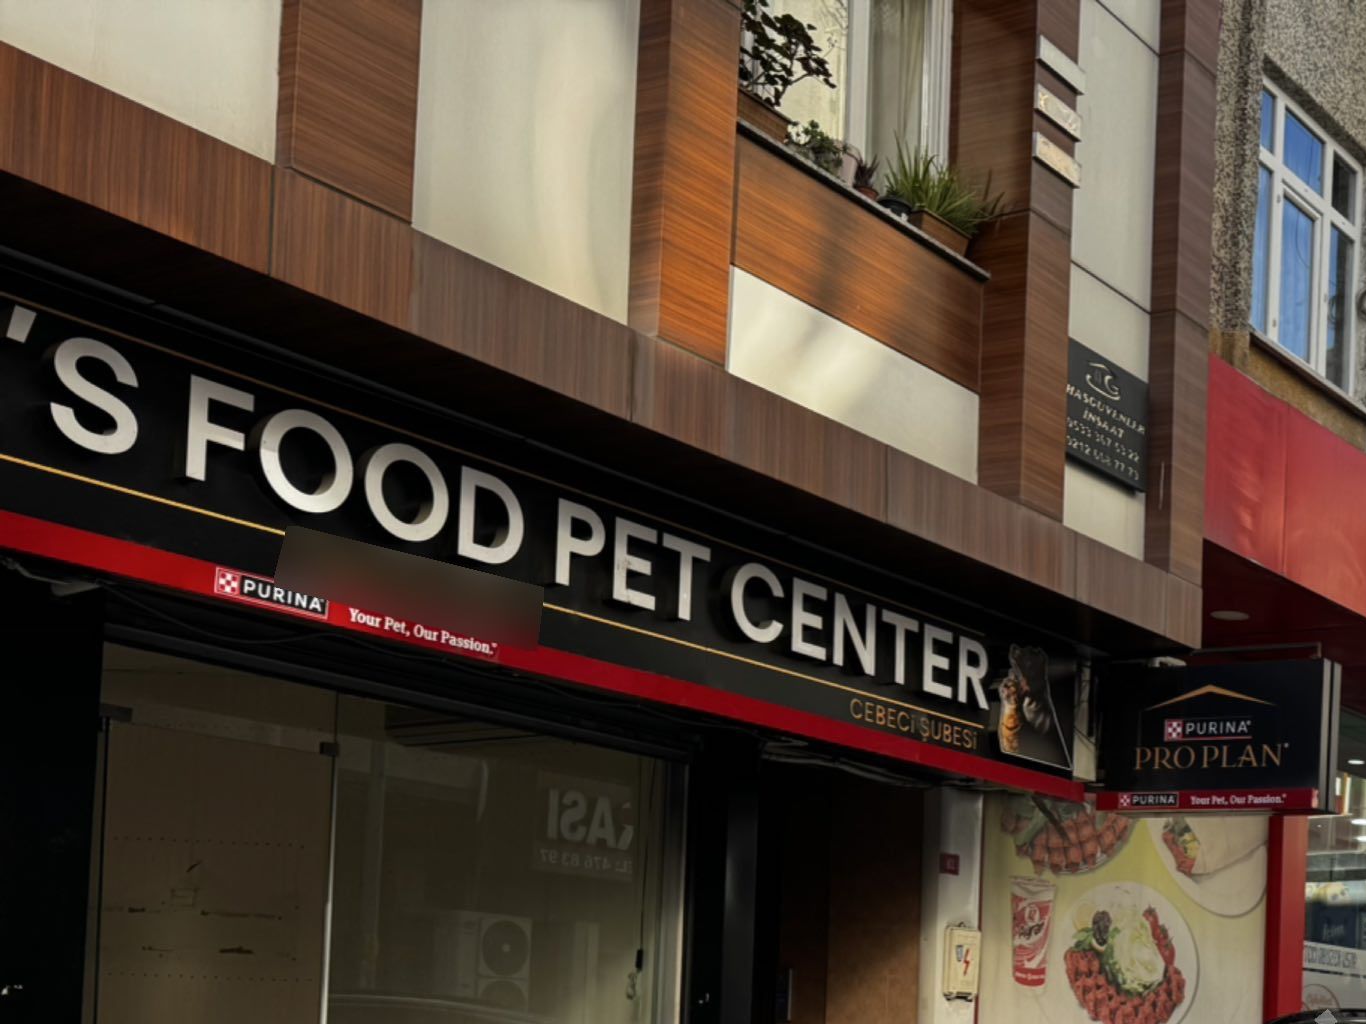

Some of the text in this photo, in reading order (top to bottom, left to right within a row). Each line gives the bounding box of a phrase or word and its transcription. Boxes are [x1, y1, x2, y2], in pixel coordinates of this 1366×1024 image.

[185, 374, 524, 565] FOOD
[555, 498, 711, 620] PET
[730, 562, 990, 711] CENTER
[243, 579, 322, 613] PURINA
[349, 608, 381, 628] Your
[384, 617, 410, 637] Pet,
[414, 624, 438, 641] Our
[1186, 721, 1249, 735] PURINA
[1135, 746, 1196, 770] PRO
[1132, 794, 1175, 804] PURINA
[1191, 796, 1210, 805] Your
[1230, 795, 1246, 804] Our
